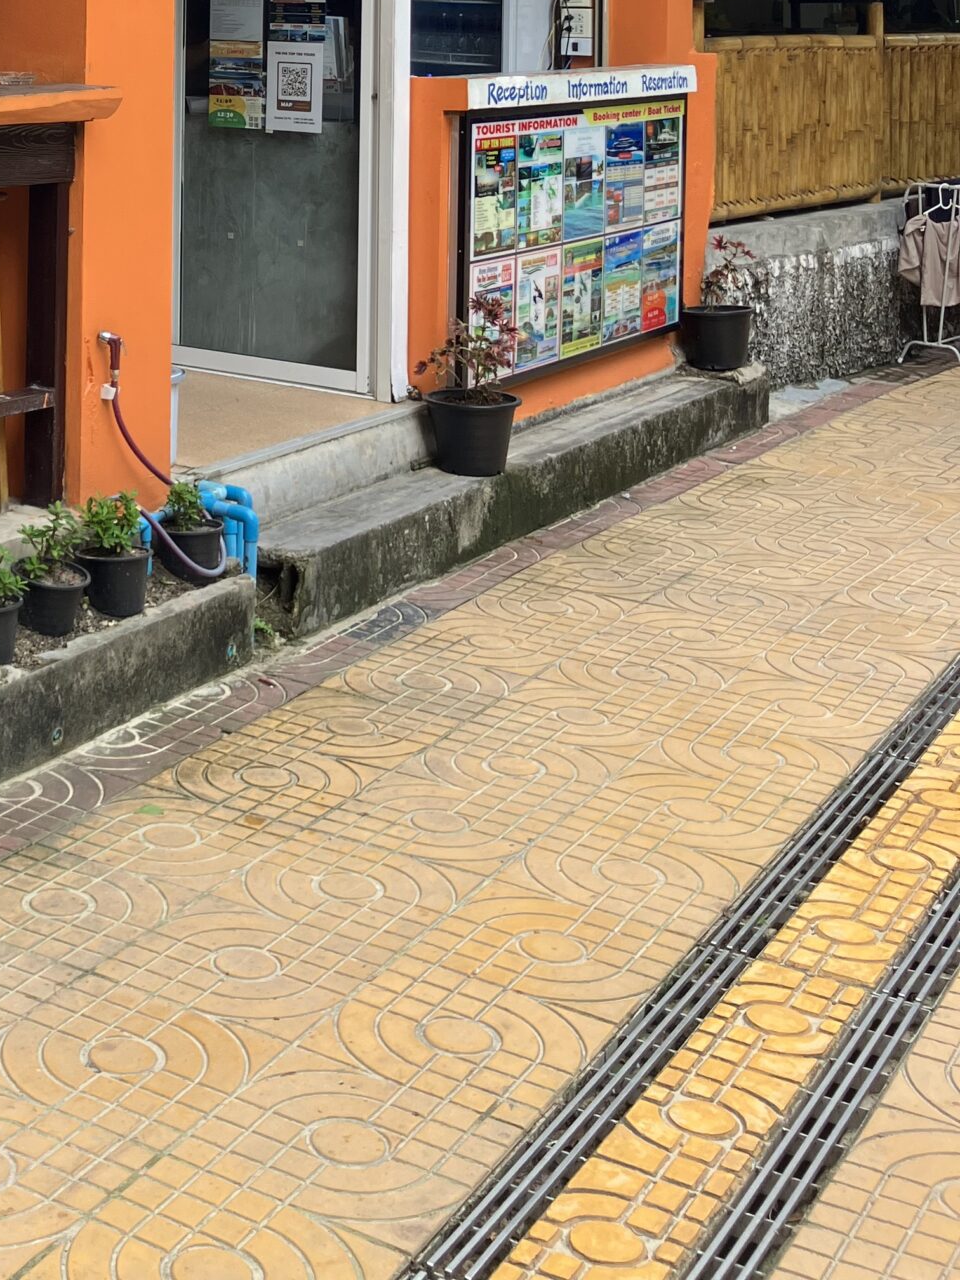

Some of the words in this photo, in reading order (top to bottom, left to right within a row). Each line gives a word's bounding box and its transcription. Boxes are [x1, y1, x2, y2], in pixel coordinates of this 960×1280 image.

[487, 80, 548, 105] Reception
[567, 76, 628, 100] Information
[593, 111, 620, 122] Booking
[622, 109, 642, 118] center
[647, 107, 662, 116] Boat
[663, 105, 681, 114] Ticket
[476, 123, 516, 135] TOURIST
[518, 117, 578, 131] INFORMATION
